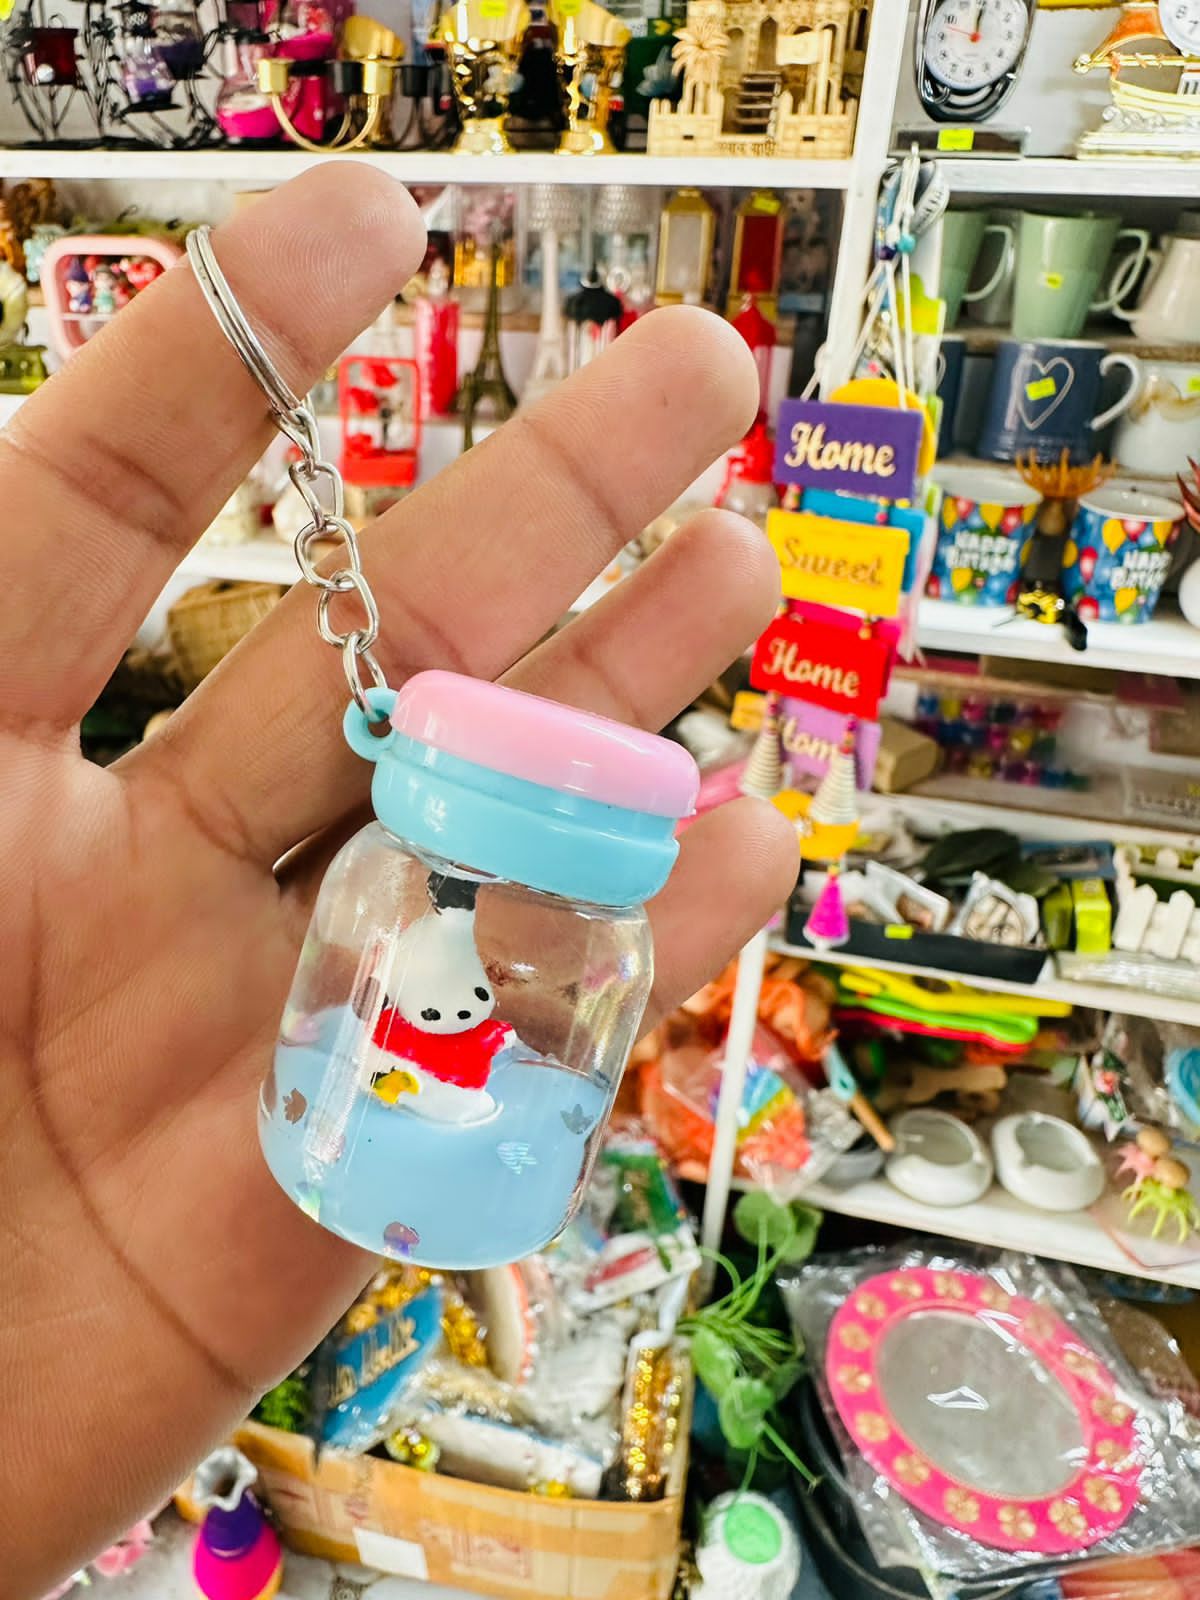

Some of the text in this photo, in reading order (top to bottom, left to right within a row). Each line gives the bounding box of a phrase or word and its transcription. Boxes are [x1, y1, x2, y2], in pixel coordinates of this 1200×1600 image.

[784, 422, 896, 477] Home
[780, 537, 883, 586] Sweet
[762, 637, 860, 698] Home
